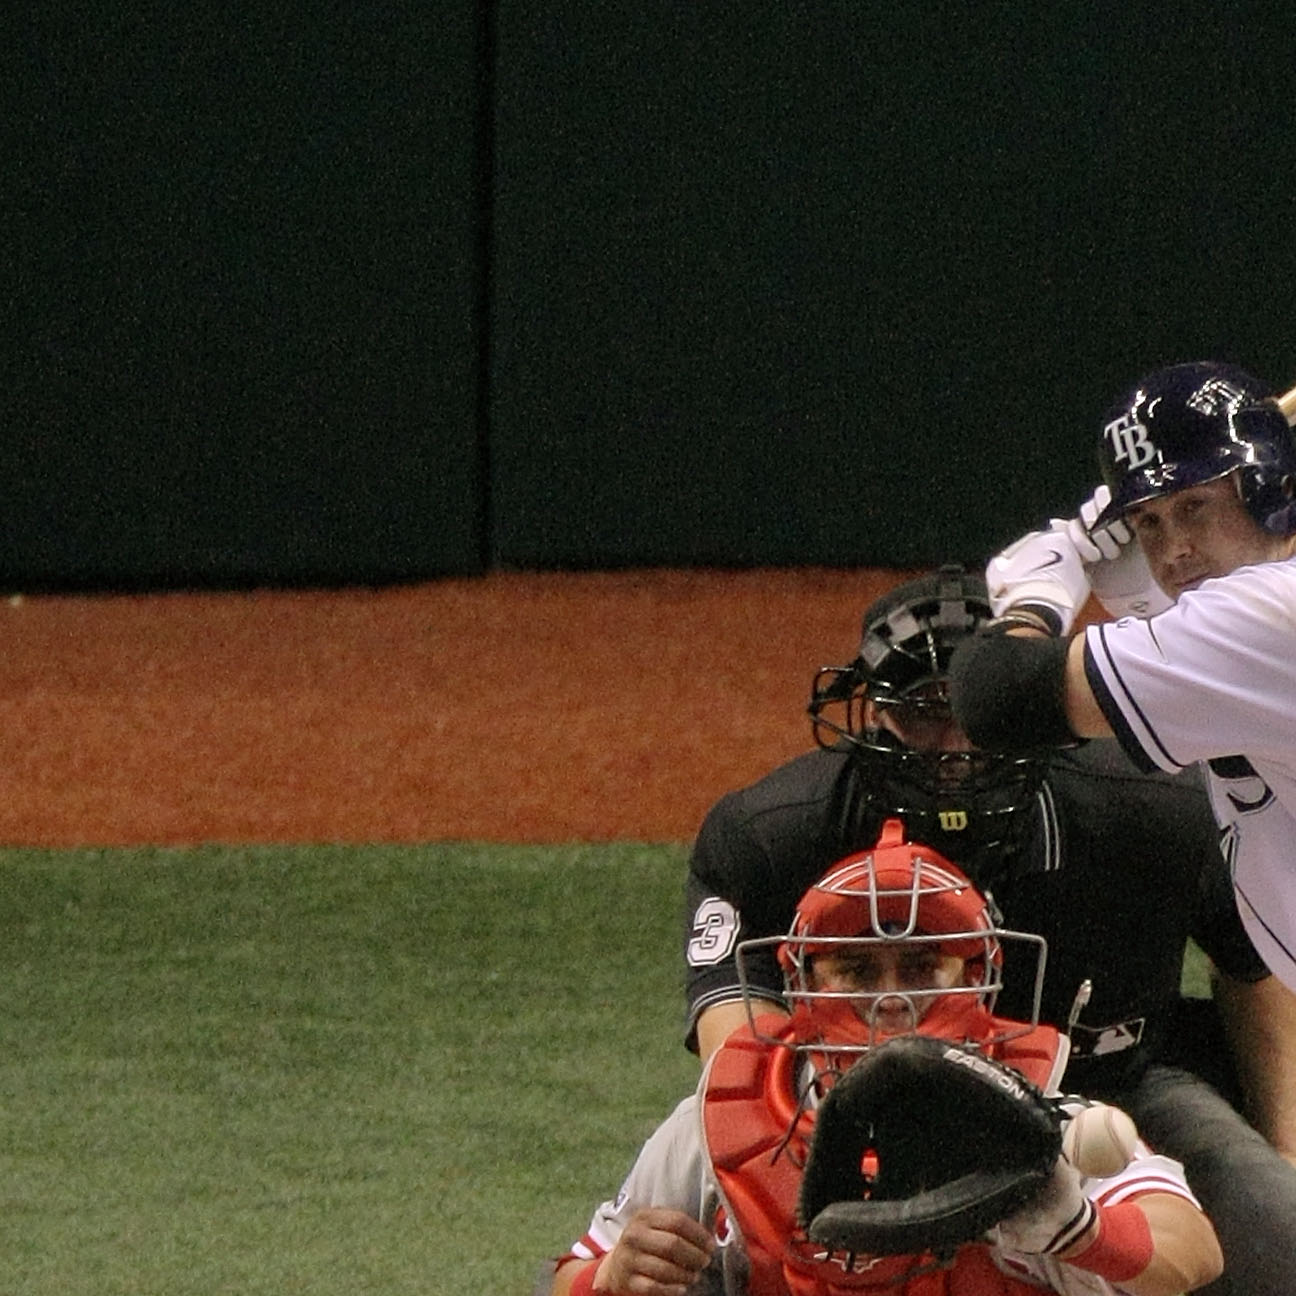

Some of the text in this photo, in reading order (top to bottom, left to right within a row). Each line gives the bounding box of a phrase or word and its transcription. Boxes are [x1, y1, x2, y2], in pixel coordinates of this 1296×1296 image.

[1104, 414, 1156, 471] TB
[687, 897, 741, 966] 3
[943, 1048, 1025, 1100] EASTON
